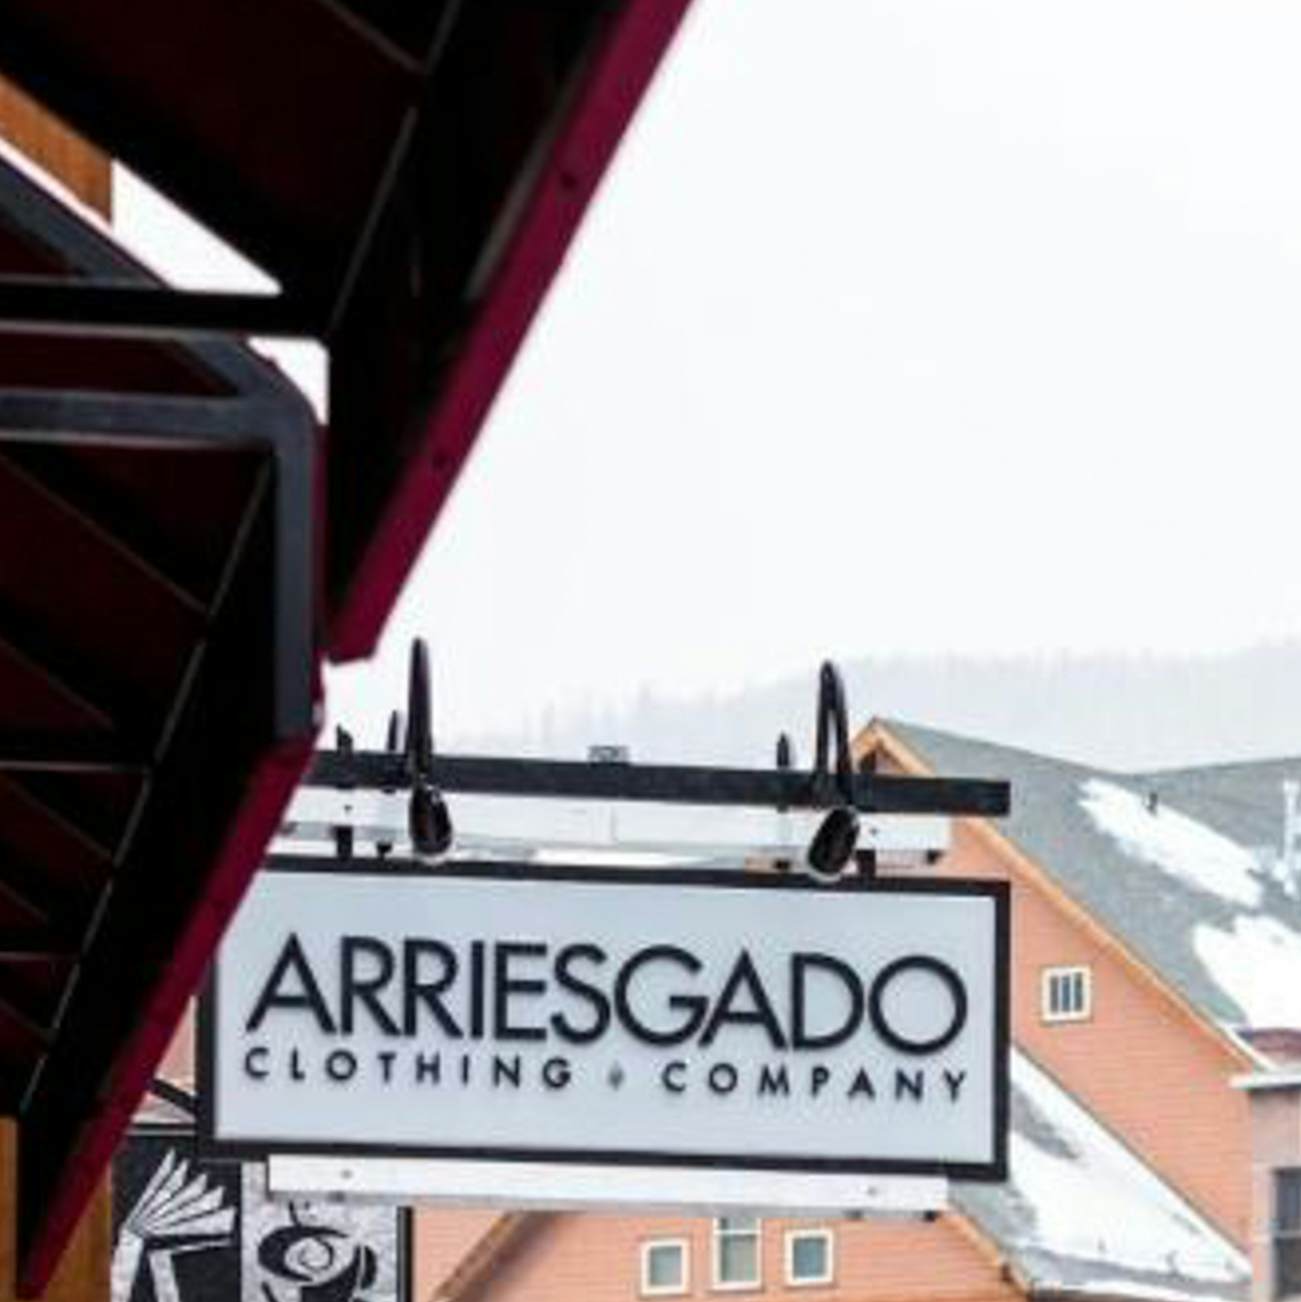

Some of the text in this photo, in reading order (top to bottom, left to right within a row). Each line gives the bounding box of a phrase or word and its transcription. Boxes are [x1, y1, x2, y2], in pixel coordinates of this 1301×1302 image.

[245, 930, 969, 1057] ARRIESGADO
[244, 1047, 970, 1105] CLOTHING COMPANY
